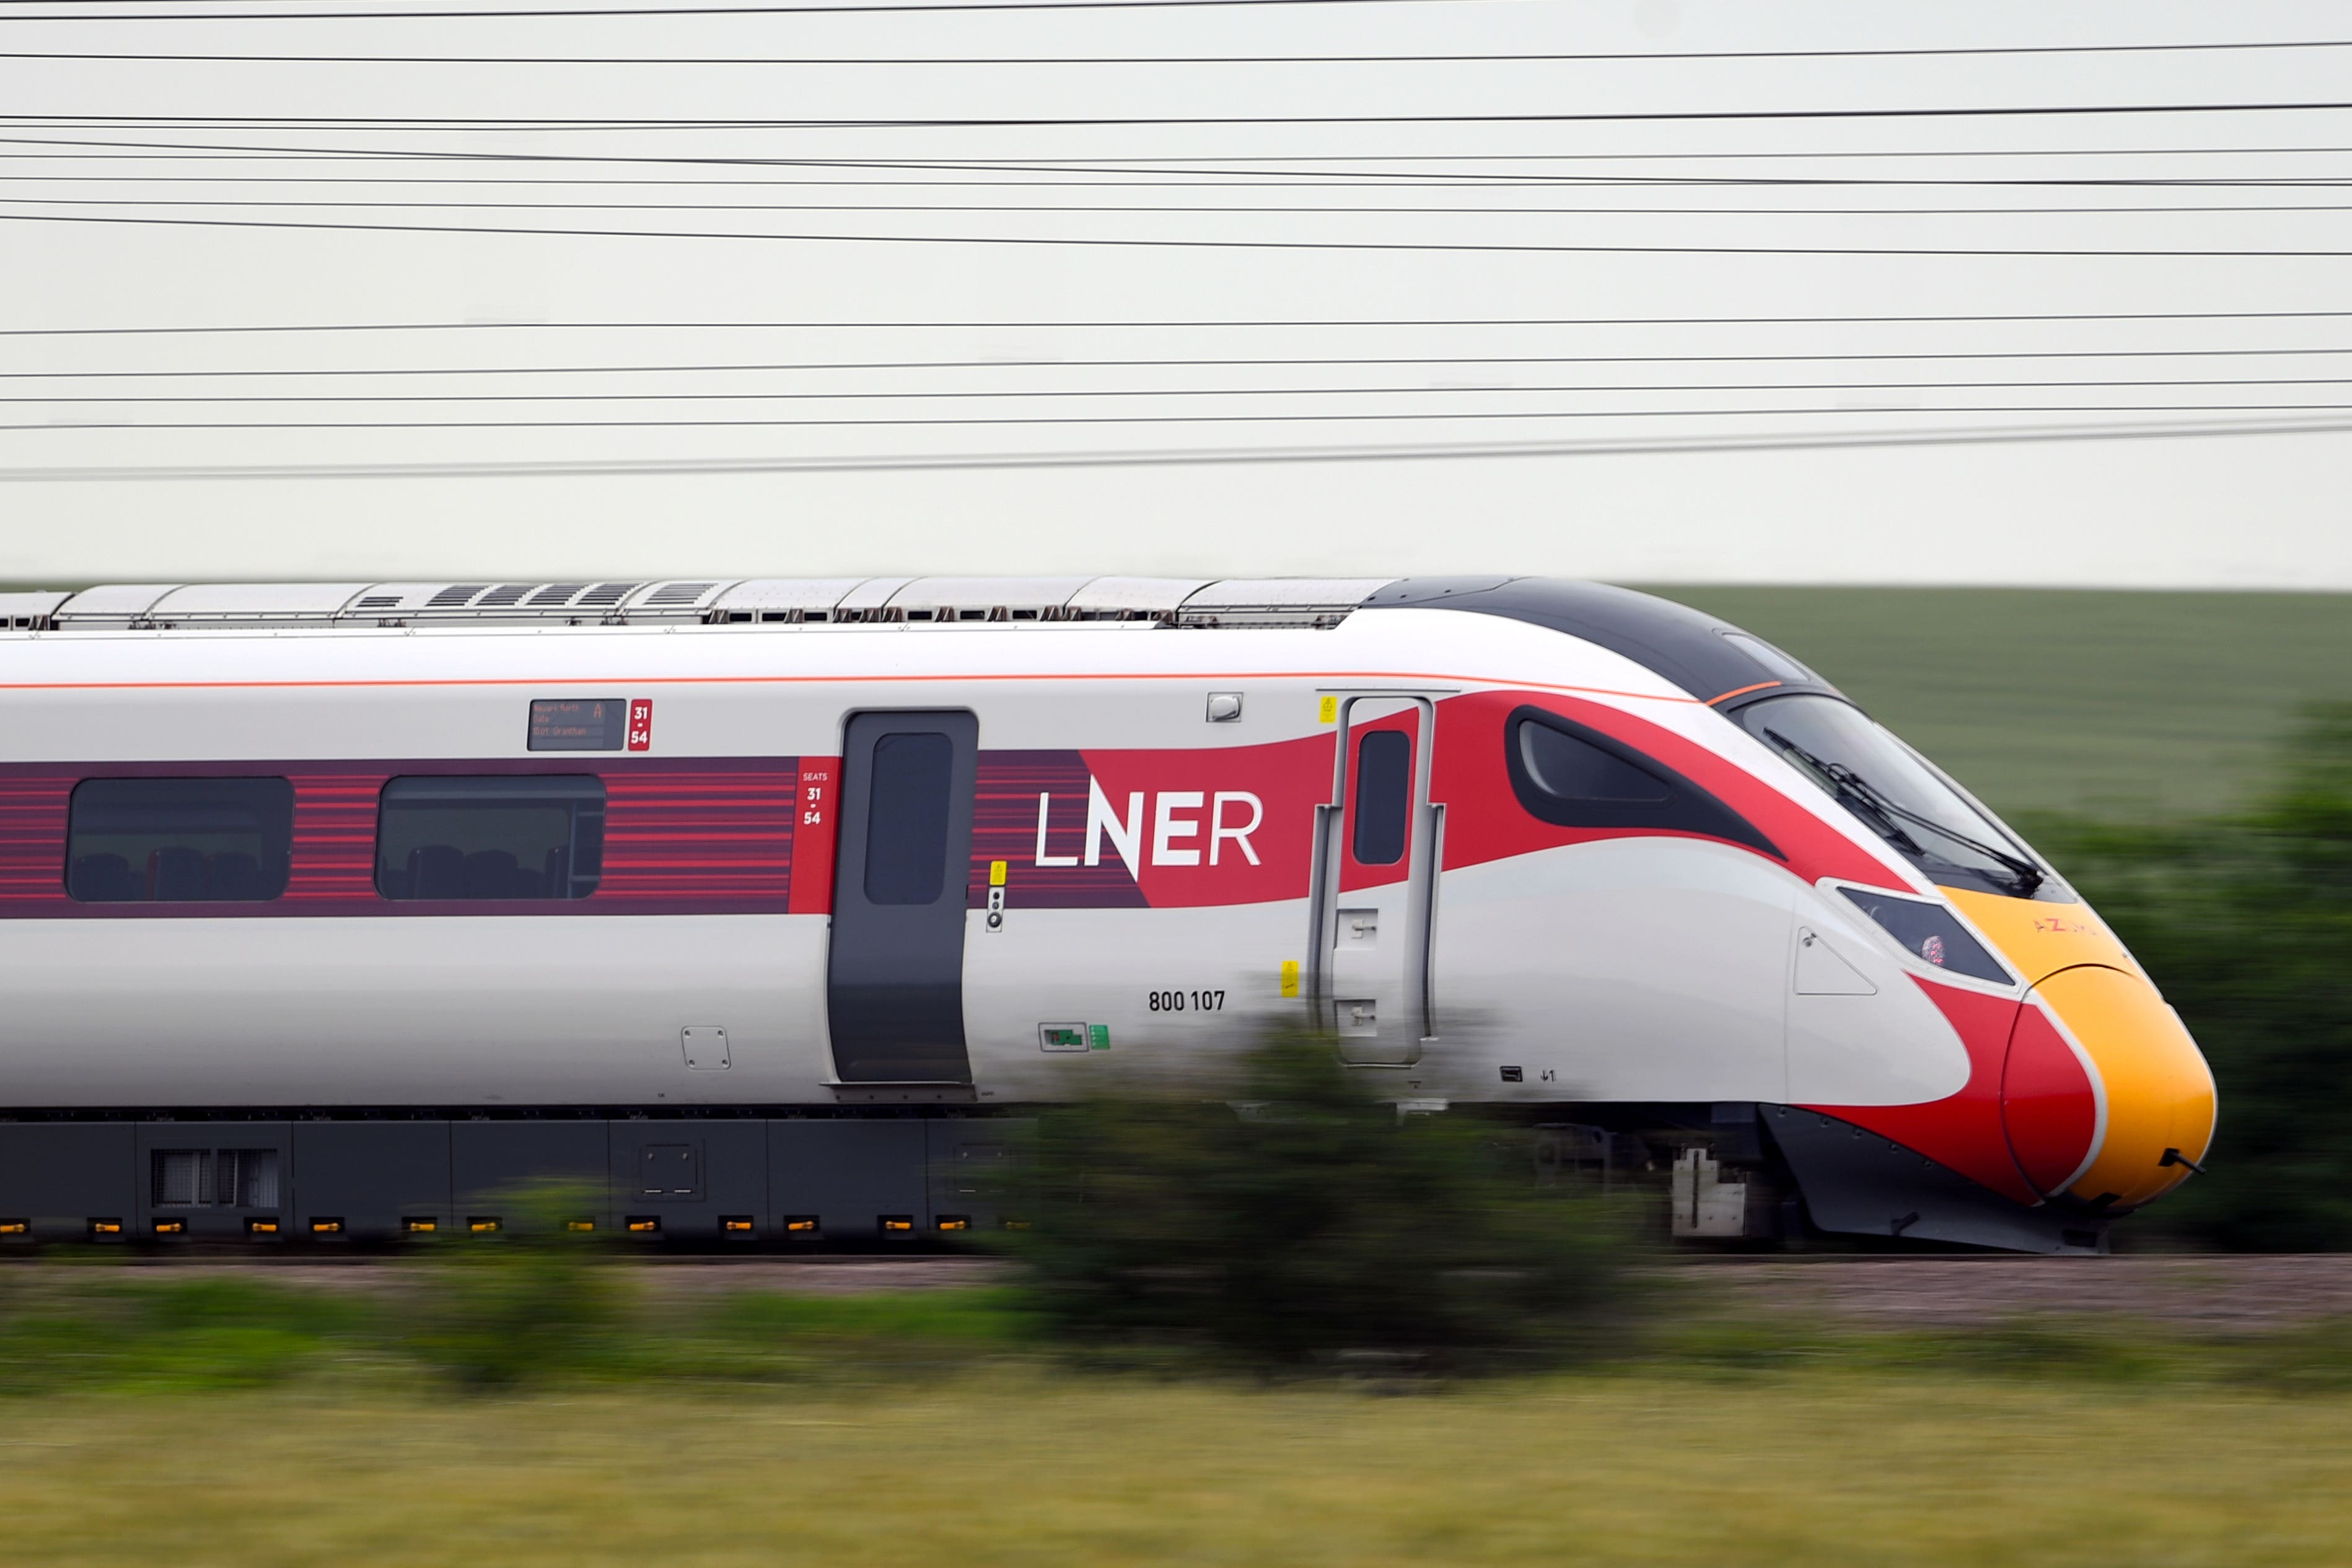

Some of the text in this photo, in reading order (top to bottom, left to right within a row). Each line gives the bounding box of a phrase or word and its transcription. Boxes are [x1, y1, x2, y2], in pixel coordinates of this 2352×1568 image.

[594, 703, 602, 718] A
[634, 707, 648, 719] 31
[631, 731, 647, 743] 54
[803, 773, 828, 781] SEATS
[807, 787, 821, 800] 31
[804, 812, 821, 825] 54
[1035, 774, 1263, 883] LNER
[1149, 991, 1225, 1011] 800 107
